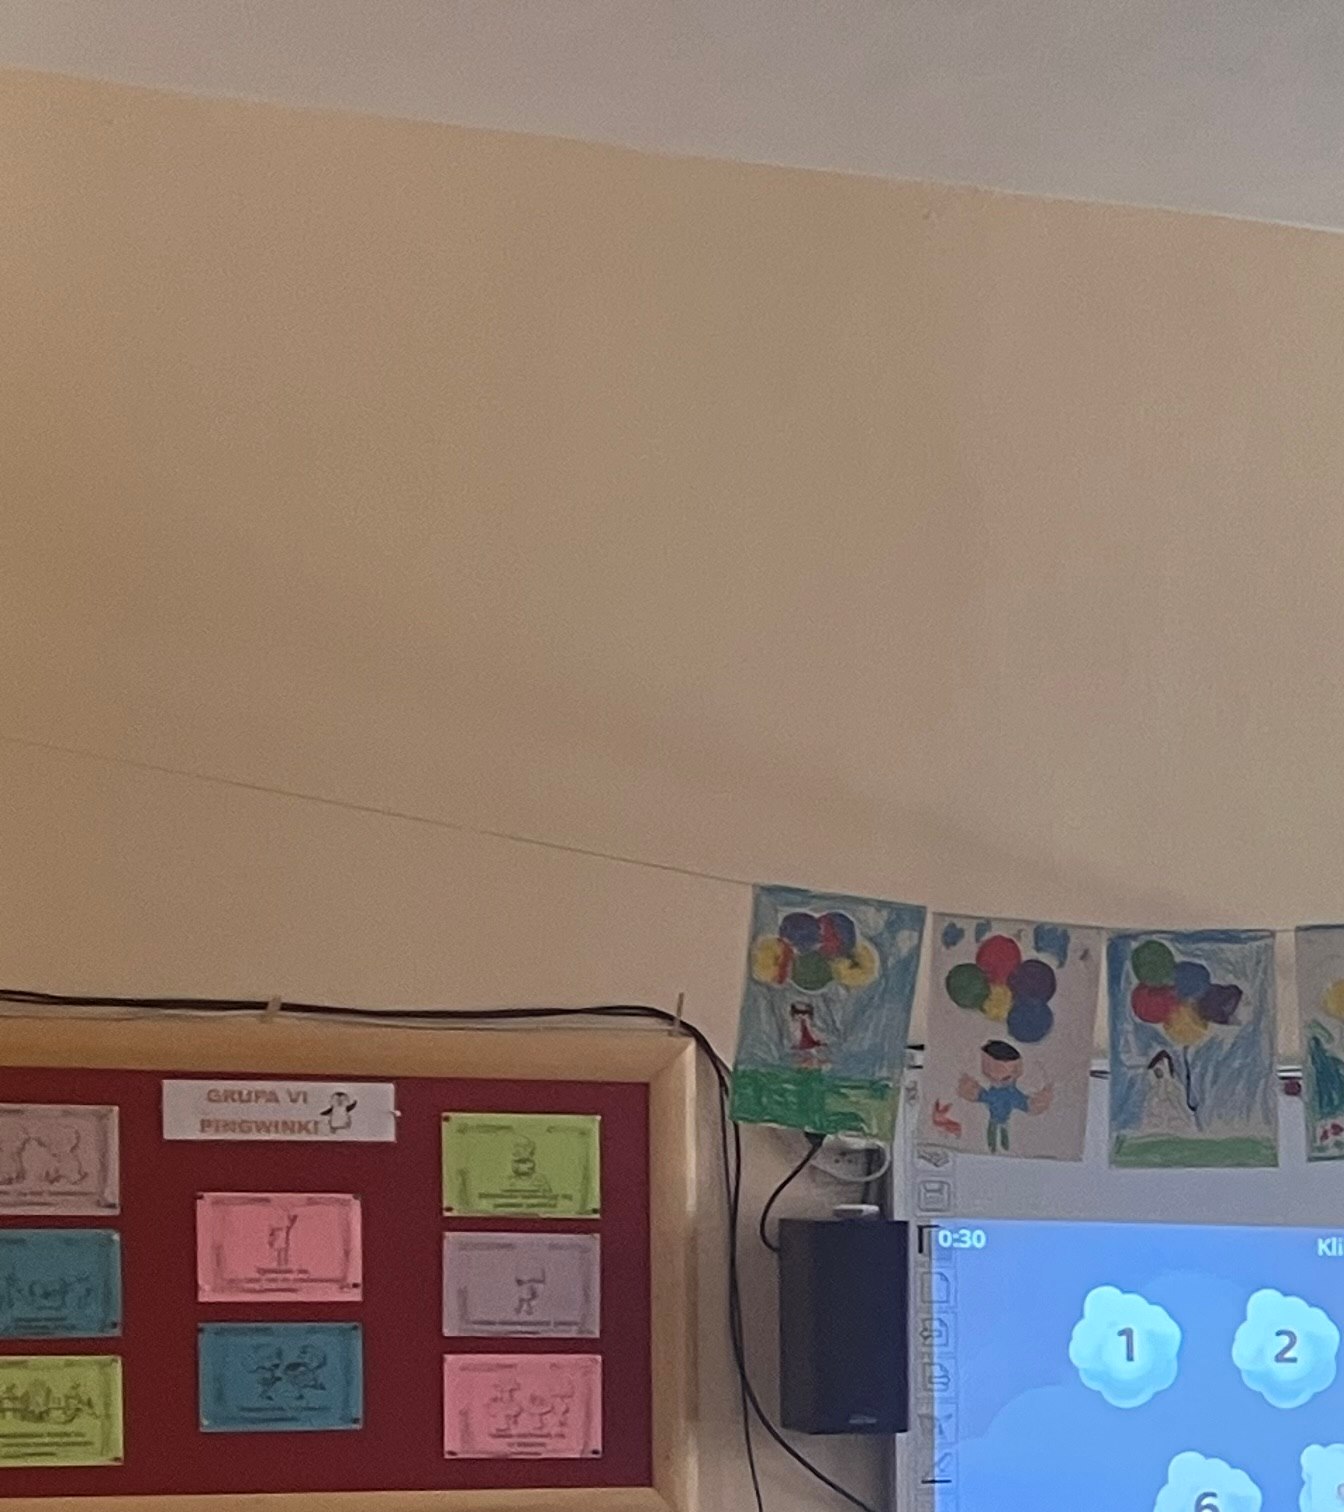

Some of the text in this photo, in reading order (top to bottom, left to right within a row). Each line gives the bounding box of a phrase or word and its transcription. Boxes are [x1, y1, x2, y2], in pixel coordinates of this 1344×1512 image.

[207, 1088, 308, 1104] GRUPA VI
[199, 1118, 320, 1134] PINGWINKI
[938, 1228, 986, 1249] 0:30
[1117, 1327, 1135, 1362] 1
[1274, 1329, 1298, 1364] 2
